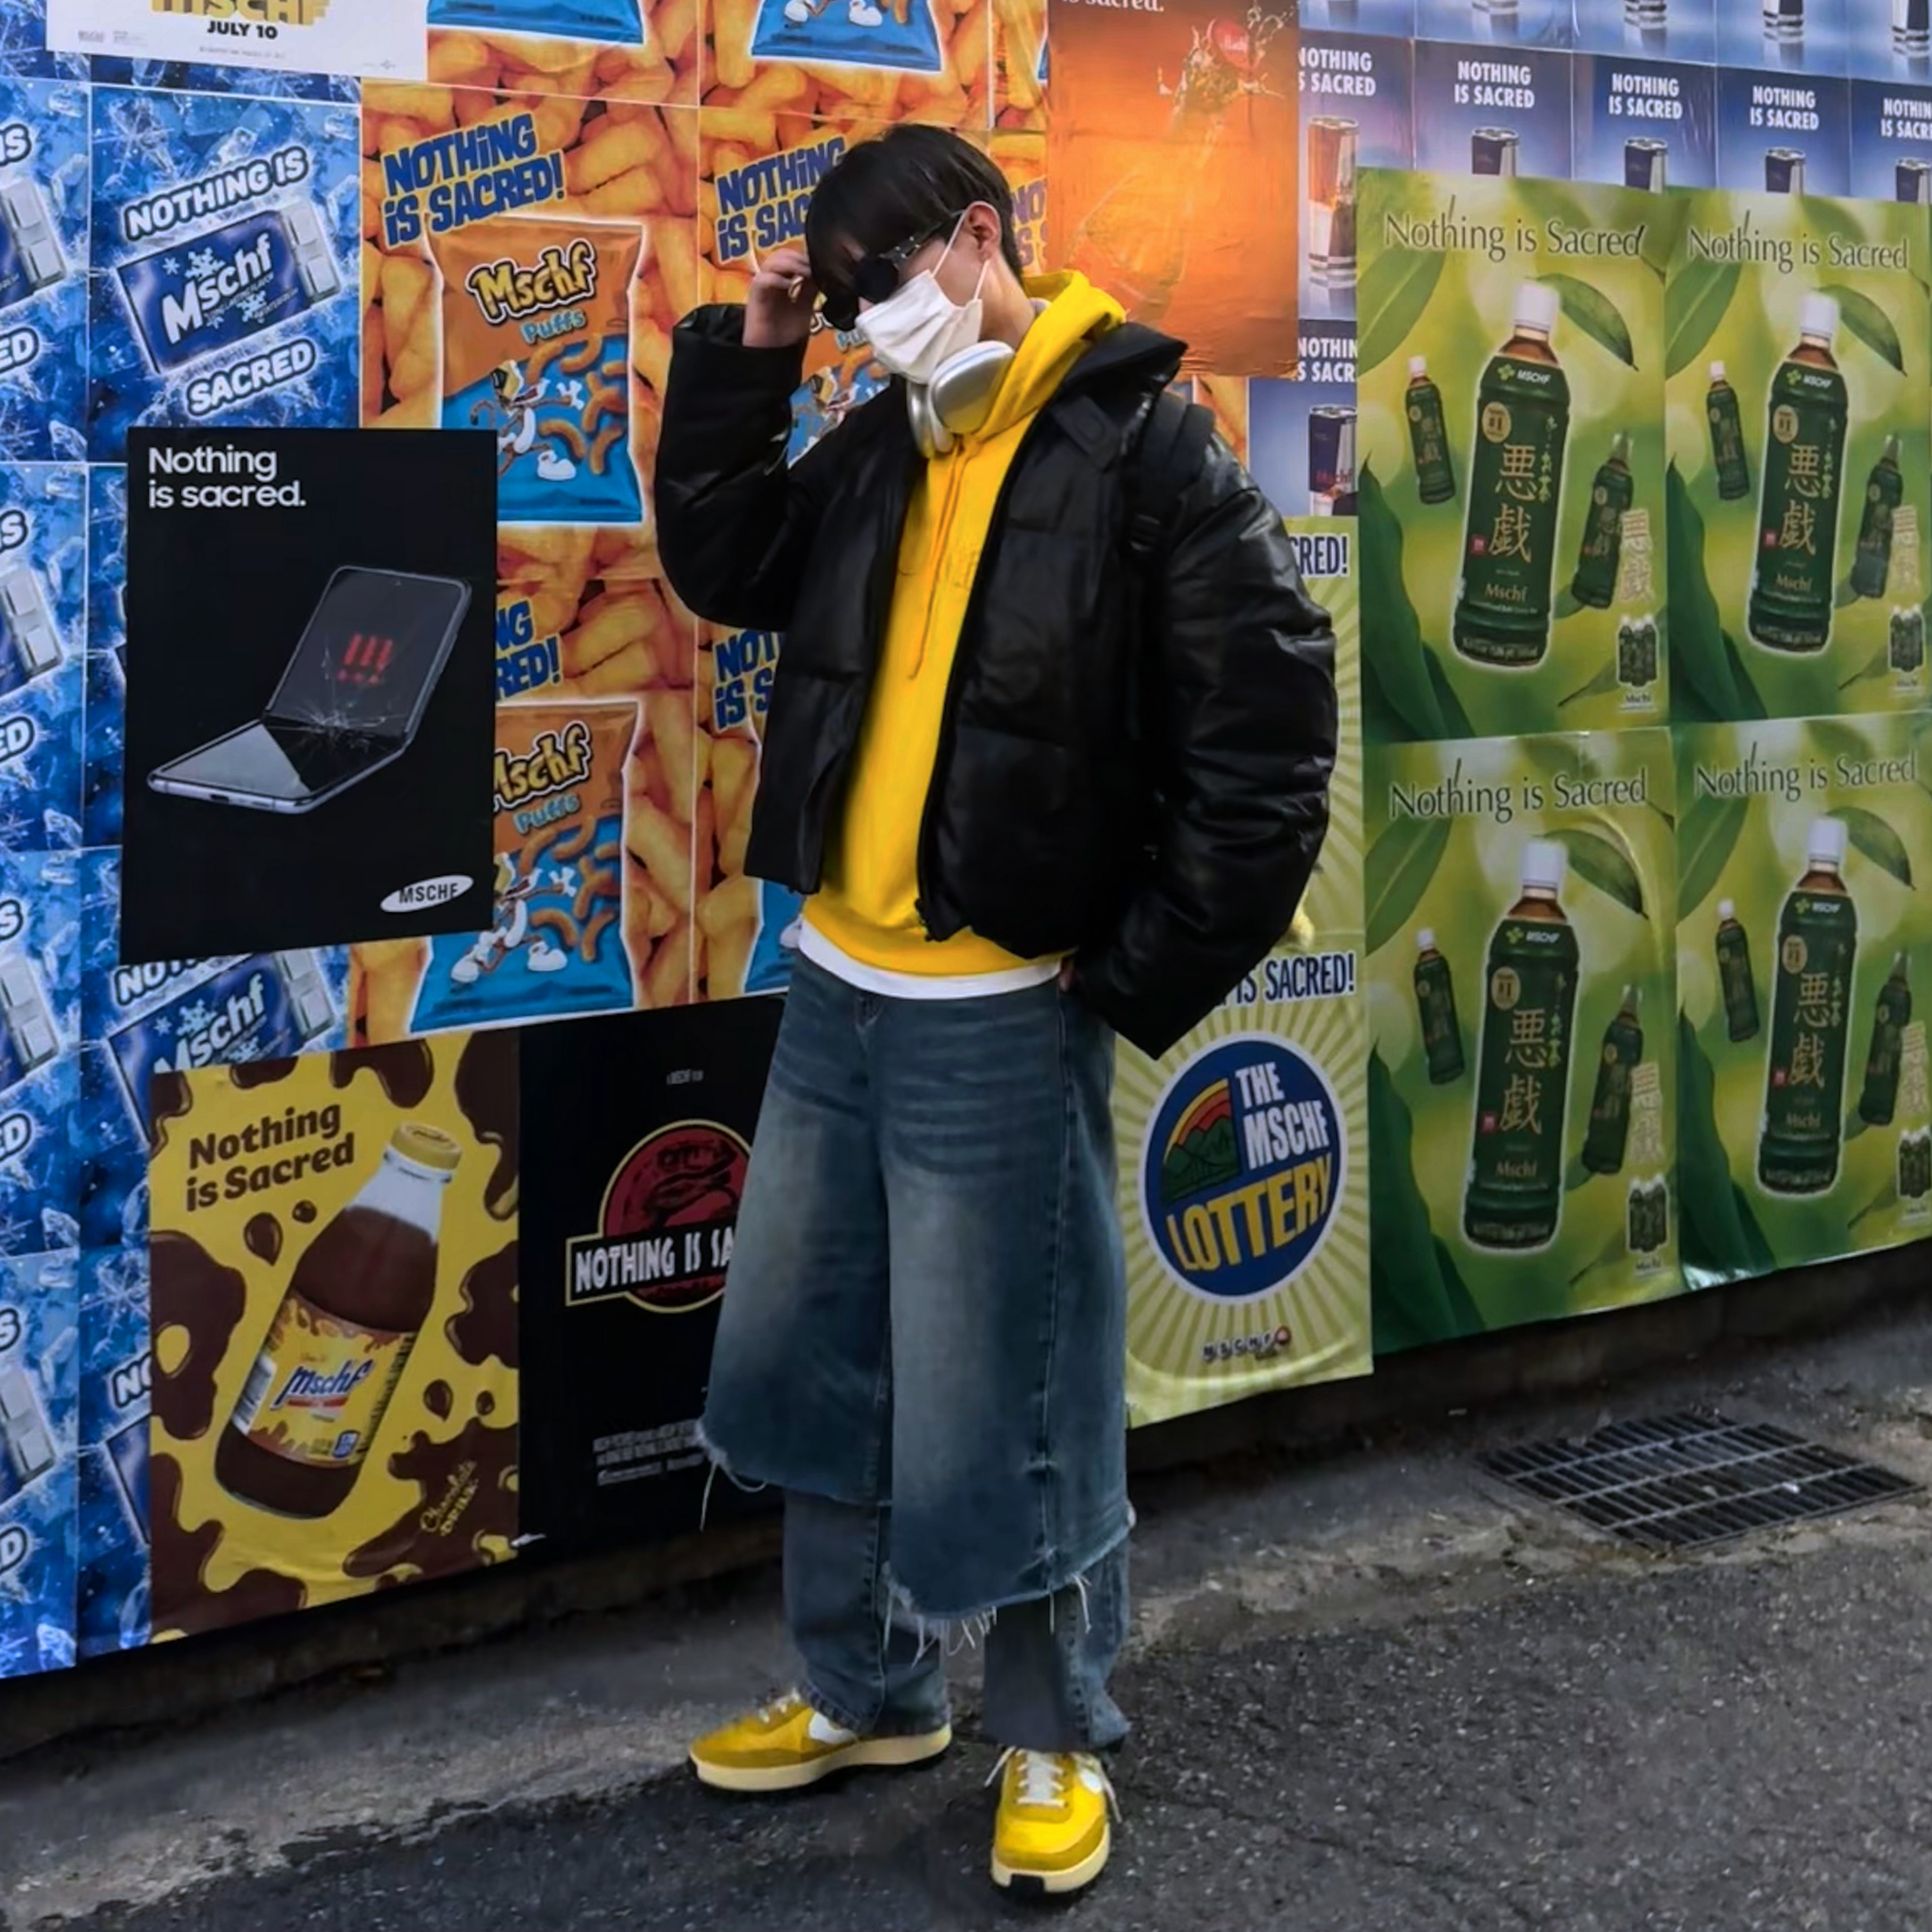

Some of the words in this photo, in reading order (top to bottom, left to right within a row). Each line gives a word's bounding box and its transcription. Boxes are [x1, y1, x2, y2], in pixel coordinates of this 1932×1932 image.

[207, 21, 252, 37] JULY
[255, 25, 279, 40] 10
[1311, 73, 1377, 96] SACRED
[1454, 84, 1469, 105] IS
[1473, 85, 1535, 109] SACRED
[1457, 61, 1531, 86] NOTHING
[1612, 74, 1680, 96] NOTHING
[1609, 95, 1623, 115] IS
[1626, 97, 1683, 120] SACRED
[1750, 108, 1764, 127] IS
[1767, 110, 1820, 130] SACRED
[1753, 86, 1816, 110] NOTHING
[1881, 119, 1894, 137] IS
[125, 159, 271, 240] NOTHING
[273, 147, 307, 185] IS
[429, 153, 564, 233] SACRED!
[1385, 202, 1505, 262] Nothing
[1517, 219, 1537, 252] is
[1547, 220, 1645, 257] Sacred
[1689, 218, 1794, 273] Nothing
[1803, 233, 1821, 265] is
[1829, 235, 1907, 269] Sacred
[162, 232, 271, 344] Mschf
[471, 241, 592, 318] Mschf
[523, 310, 585, 343] Puffs
[187, 339, 315, 416] SACRED
[149, 445, 277, 481] Nothing
[149, 479, 173, 508] is
[182, 481, 306, 507] sacred.
[1391, 766, 1512, 824] Nothing
[1523, 777, 1543, 810] is
[1554, 768, 1646, 808] Sacred
[1697, 751, 1801, 802] Nothing
[1810, 759, 1827, 789] is
[1836, 753, 1916, 788] Sacred
[515, 794, 579, 833] Puffs
[398, 882, 459, 903] MSCHF
[1265, 953, 1354, 1000] SACRED!
[1235, 1062, 1285, 1109] THE
[189, 1104, 341, 1170] Nothing
[1243, 1101, 1329, 1170] MSCHF
[187, 1177, 219, 1212] is
[224, 1133, 355, 1200] Sacred
[1166, 1154, 1332, 1270] LOTTERY
[576, 1237, 675, 1293] NOTHING
[685, 1232, 701, 1273] IS
